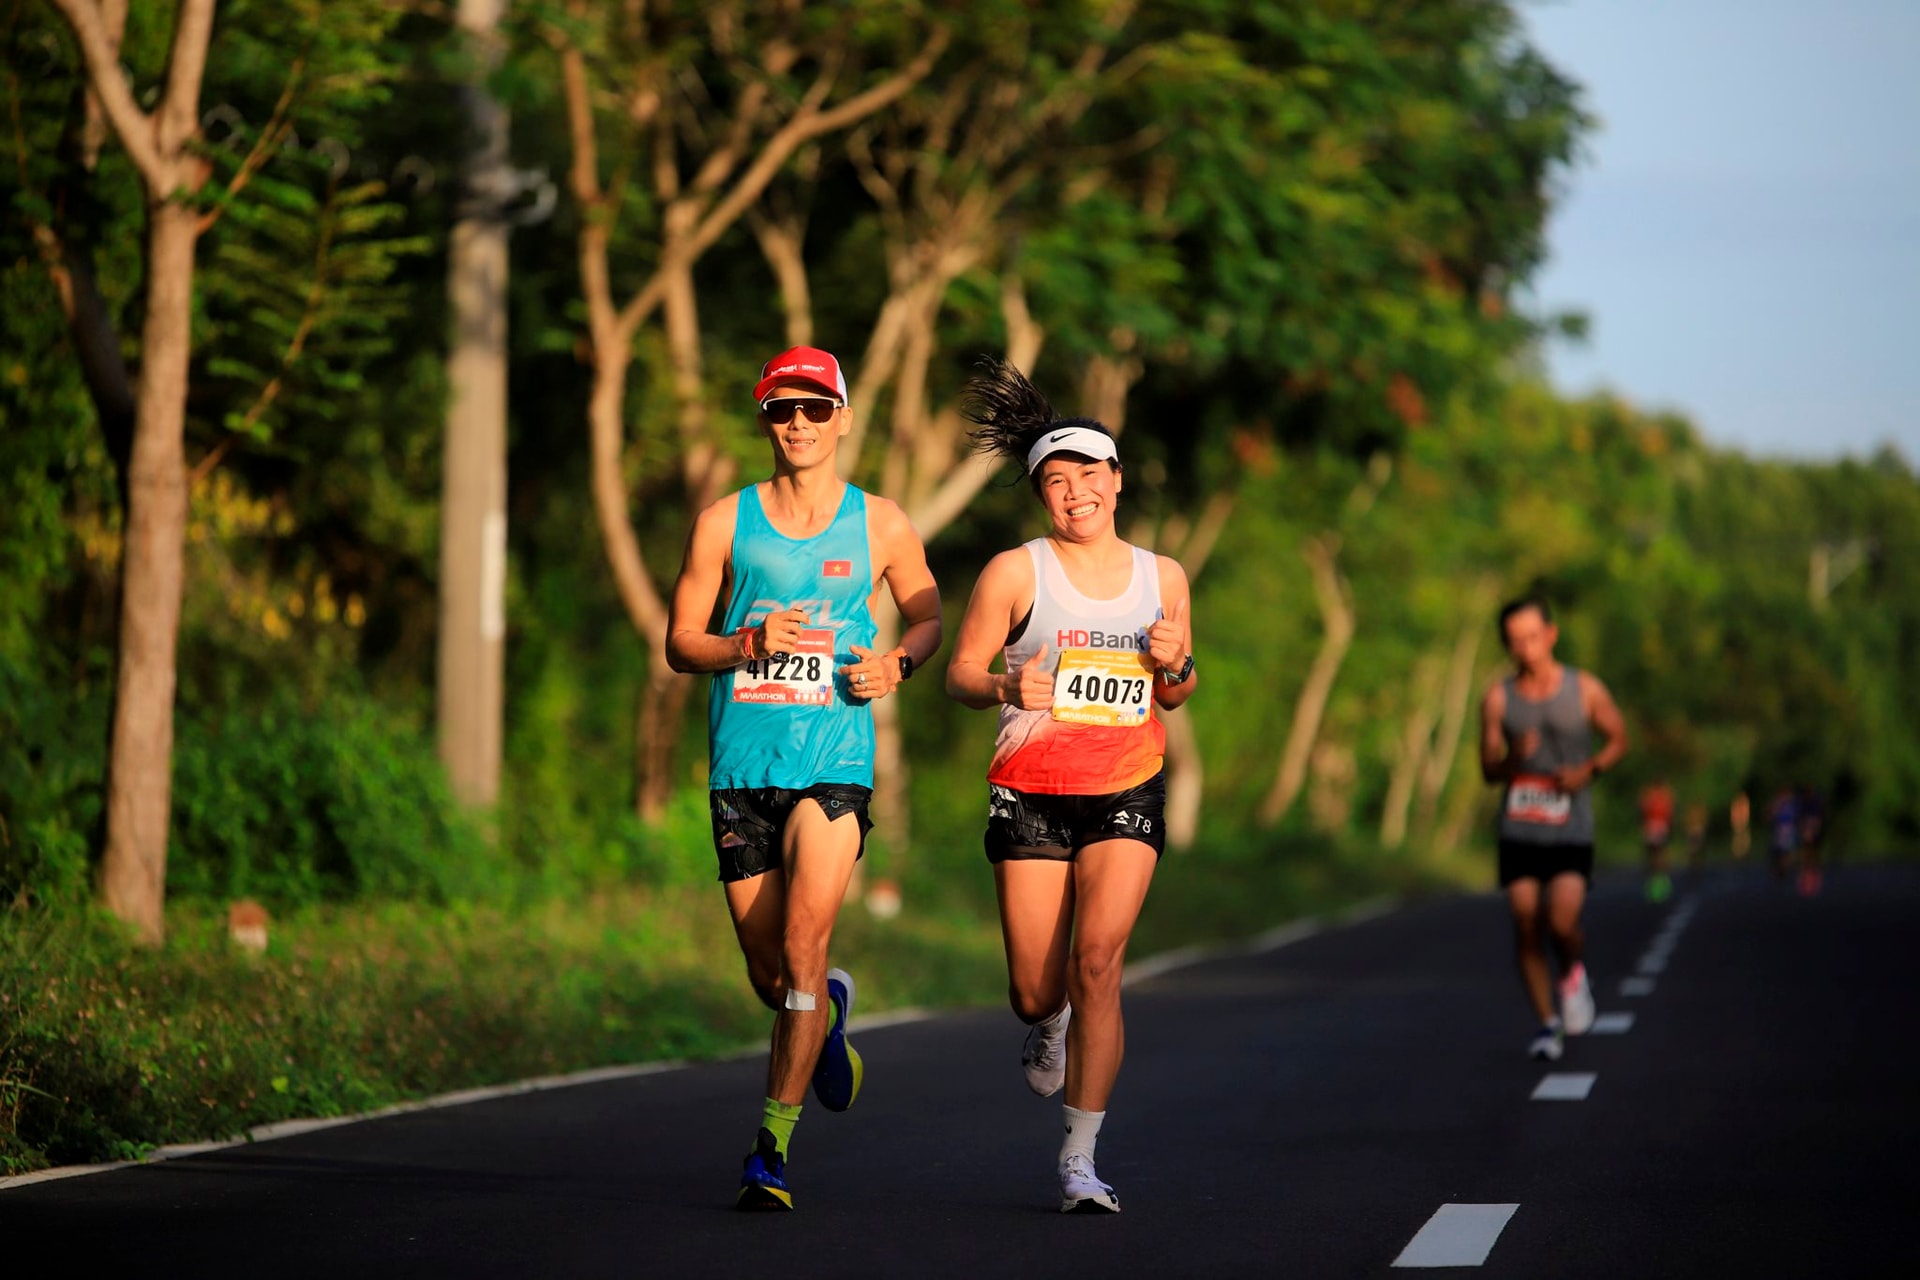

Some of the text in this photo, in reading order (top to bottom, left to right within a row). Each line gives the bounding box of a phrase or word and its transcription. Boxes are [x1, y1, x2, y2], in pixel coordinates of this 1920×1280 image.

[1057, 629, 1146, 650] HDBank
[746, 656, 821, 681] 41228
[739, 692, 786, 701] MARATHON
[1067, 674, 1145, 704] 40073
[1134, 813, 1152, 834] T8
